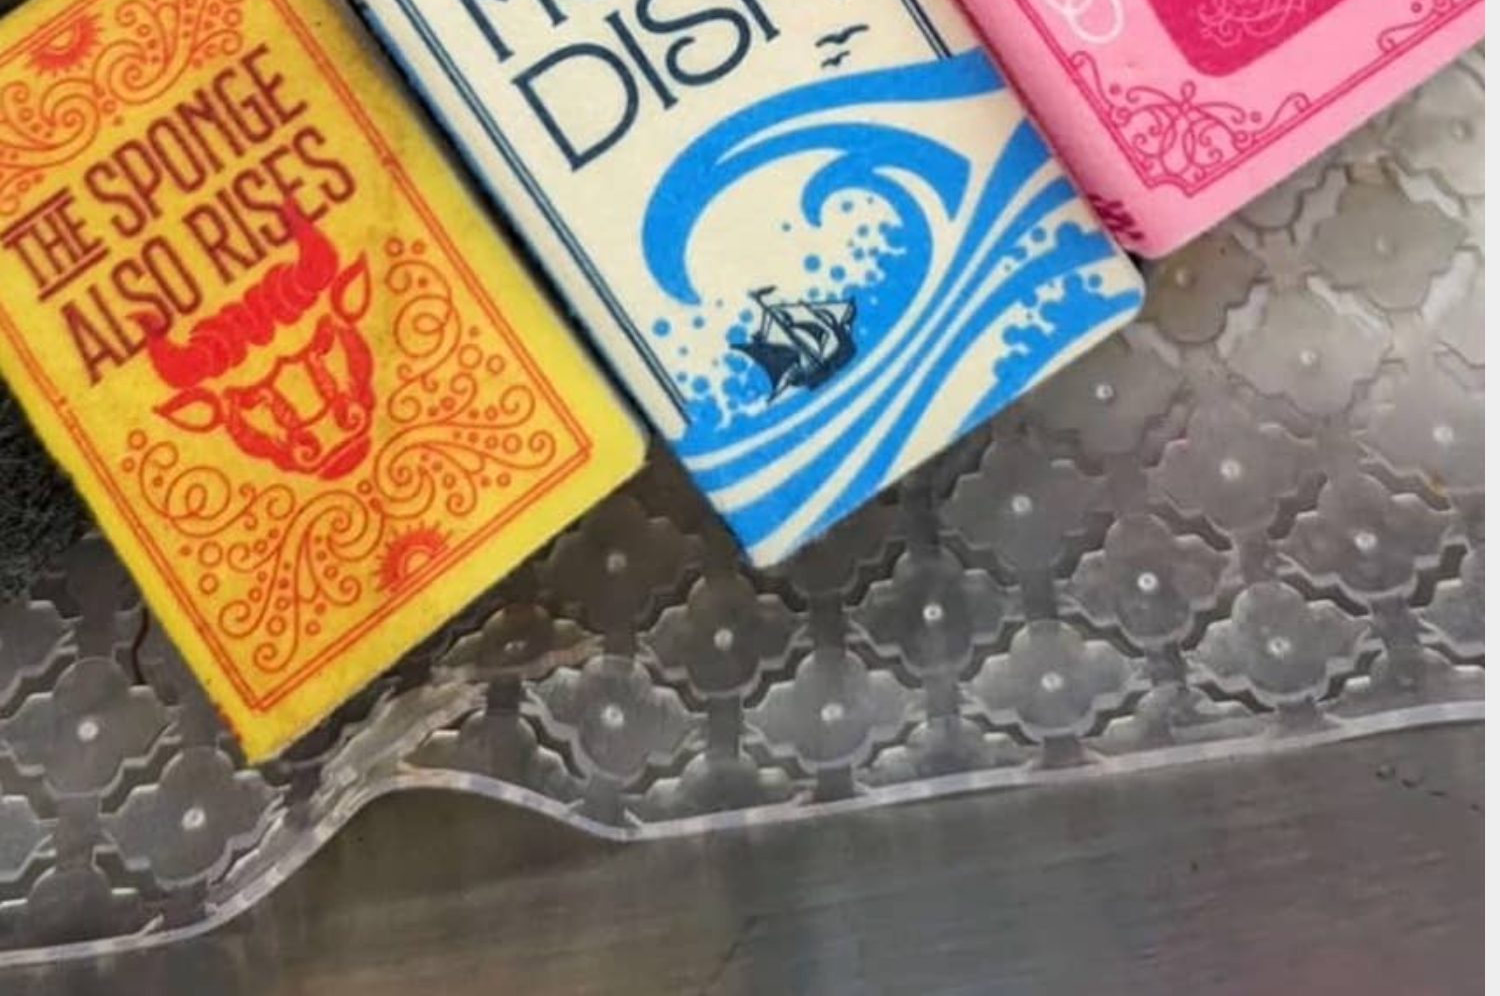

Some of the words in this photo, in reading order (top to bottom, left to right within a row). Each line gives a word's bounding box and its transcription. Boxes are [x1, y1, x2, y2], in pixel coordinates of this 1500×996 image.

[2, 196, 108, 294] THE
[83, 43, 308, 239] SPONGE
[61, 236, 203, 387] ALSO
[182, 126, 356, 287] RISES
